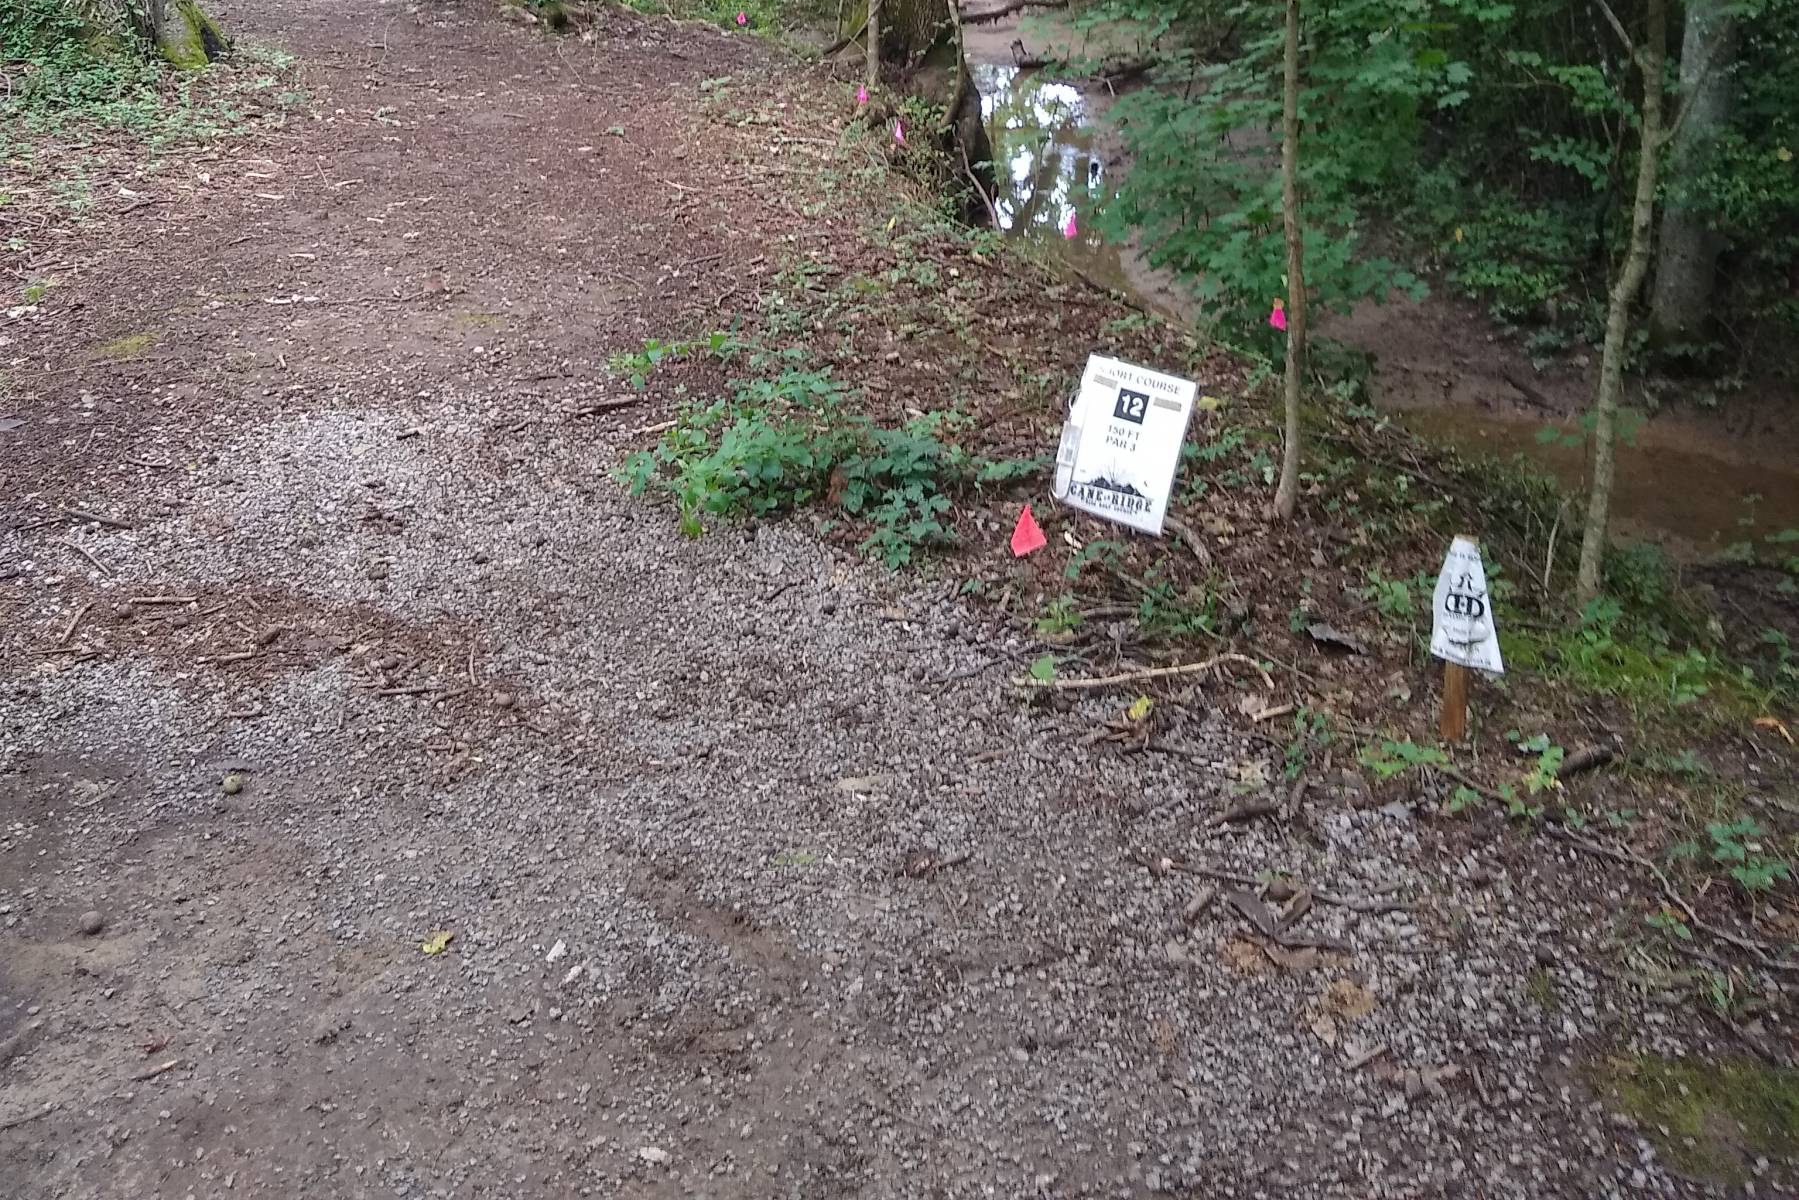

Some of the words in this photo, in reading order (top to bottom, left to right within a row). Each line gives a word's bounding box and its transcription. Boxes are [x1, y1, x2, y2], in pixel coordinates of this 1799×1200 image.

[1136, 375, 1181, 395] COURSE
[1121, 394, 1144, 418] 12
[1105, 435, 1128, 449] PAR
[1127, 429, 1141, 441] FT
[1070, 484, 1104, 501] CANE
[1111, 492, 1154, 513] RIDGE
